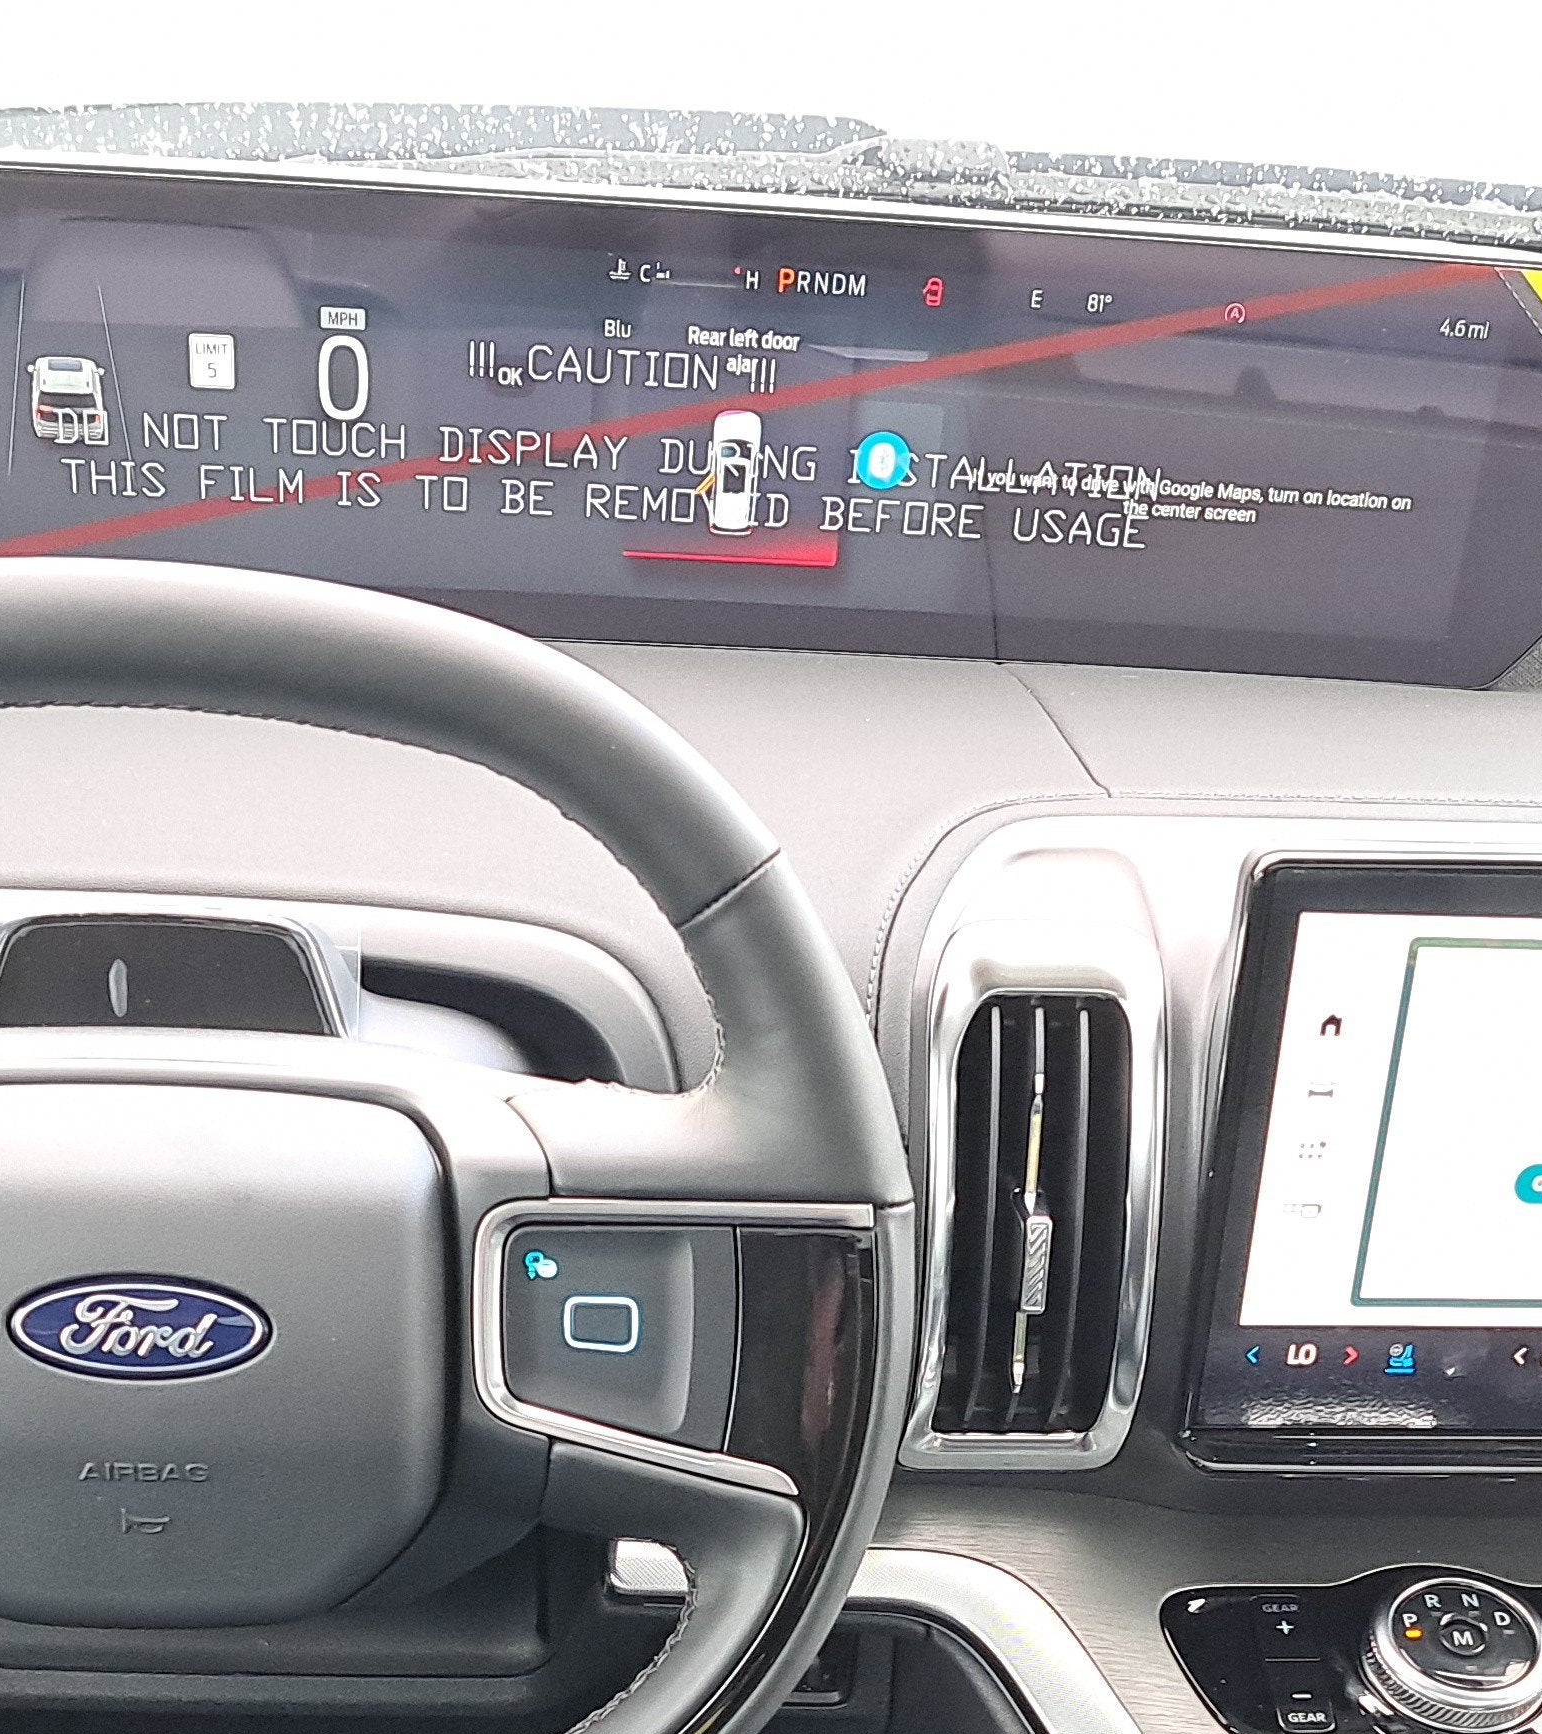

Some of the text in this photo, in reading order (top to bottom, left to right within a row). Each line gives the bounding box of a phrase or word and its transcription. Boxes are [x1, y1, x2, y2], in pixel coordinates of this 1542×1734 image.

[639, 264, 652, 283] C
[745, 270, 759, 290] H
[1030, 289, 1044, 309] E
[328, 311, 358, 327] MPH
[1439, 318, 1467, 337] 4.6
[688, 325, 801, 351] Rear left door
[195, 343, 229, 356] LIMIT
[207, 362, 217, 379] 5
[527, 344, 719, 392] CAUTION
[725, 354, 758, 376] ajar
[318, 334, 369, 421] 0
[496, 366, 523, 388] OK
[53, 409, 109, 445] DO
[141, 412, 228, 451] NOT
[263, 417, 406, 461] TOUCH
[439, 426, 629, 471] DISPLAY
[1019, 474, 1058, 491] want
[1061, 475, 1078, 491] to
[1080, 474, 1119, 494] drive
[1159, 479, 1214, 502] Google
[1217, 482, 1264, 504] Maps,
[1267, 487, 1300, 505] turn
[1303, 491, 1323, 507] on
[1326, 489, 1389, 512] location
[1391, 495, 1413, 512] on
[61, 458, 166, 499] THIS
[200, 465, 306, 505] FILM
[337, 470, 381, 509] IS
[416, 475, 468, 512] TO
[500, 478, 555, 517] BE
[819, 497, 984, 540] BEFORE
[1012, 506, 1147, 549] USAGE
[1122, 499, 1257, 524] the center screen
[60, 1294, 217, 1358] Ford
[1286, 1343, 1319, 1366] LO
[79, 1461, 210, 1482] AIRBAG
[1262, 1603, 1299, 1613] GEAR
[1424, 1594, 1441, 1609] R
[1461, 1593, 1480, 1607] N
[1402, 1613, 1418, 1628] P
[1493, 1612, 1511, 1626] D
[1453, 1631, 1474, 1646] M
[1287, 1712, 1327, 1723] GEAR
